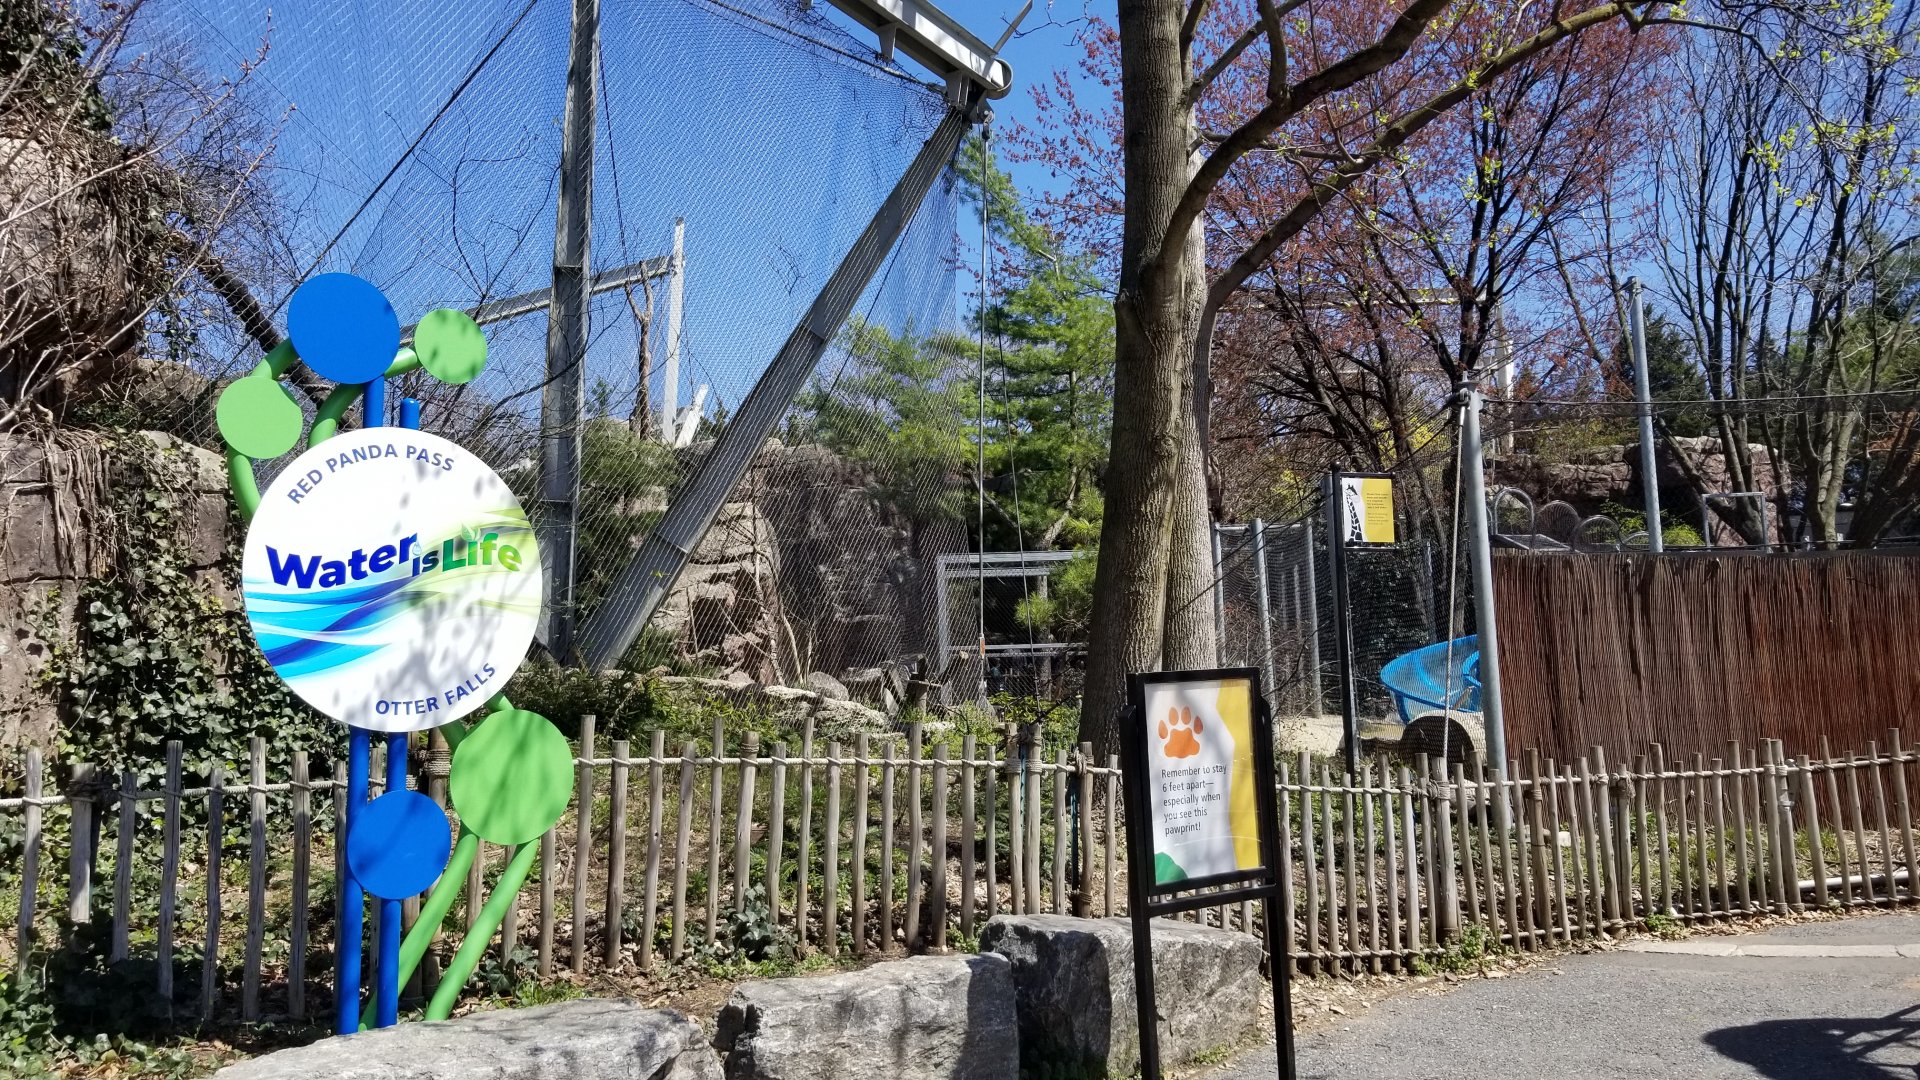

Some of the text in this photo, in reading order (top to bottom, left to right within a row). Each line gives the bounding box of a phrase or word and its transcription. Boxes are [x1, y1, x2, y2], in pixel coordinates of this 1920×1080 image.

[287, 443, 455, 504] RED PANDA PASS
[265, 529, 523, 589] Water is Life
[375, 662, 496, 715] OTTER FALLS
[1161, 765, 1227, 778] Remember to stay
[1162, 782, 1168, 792] 6
[1169, 781, 1184, 792] feet
[1163, 792, 1221, 808] especially when
[1163, 806, 1208, 823] you see this
[1164, 821, 1201, 837] pawprint!
